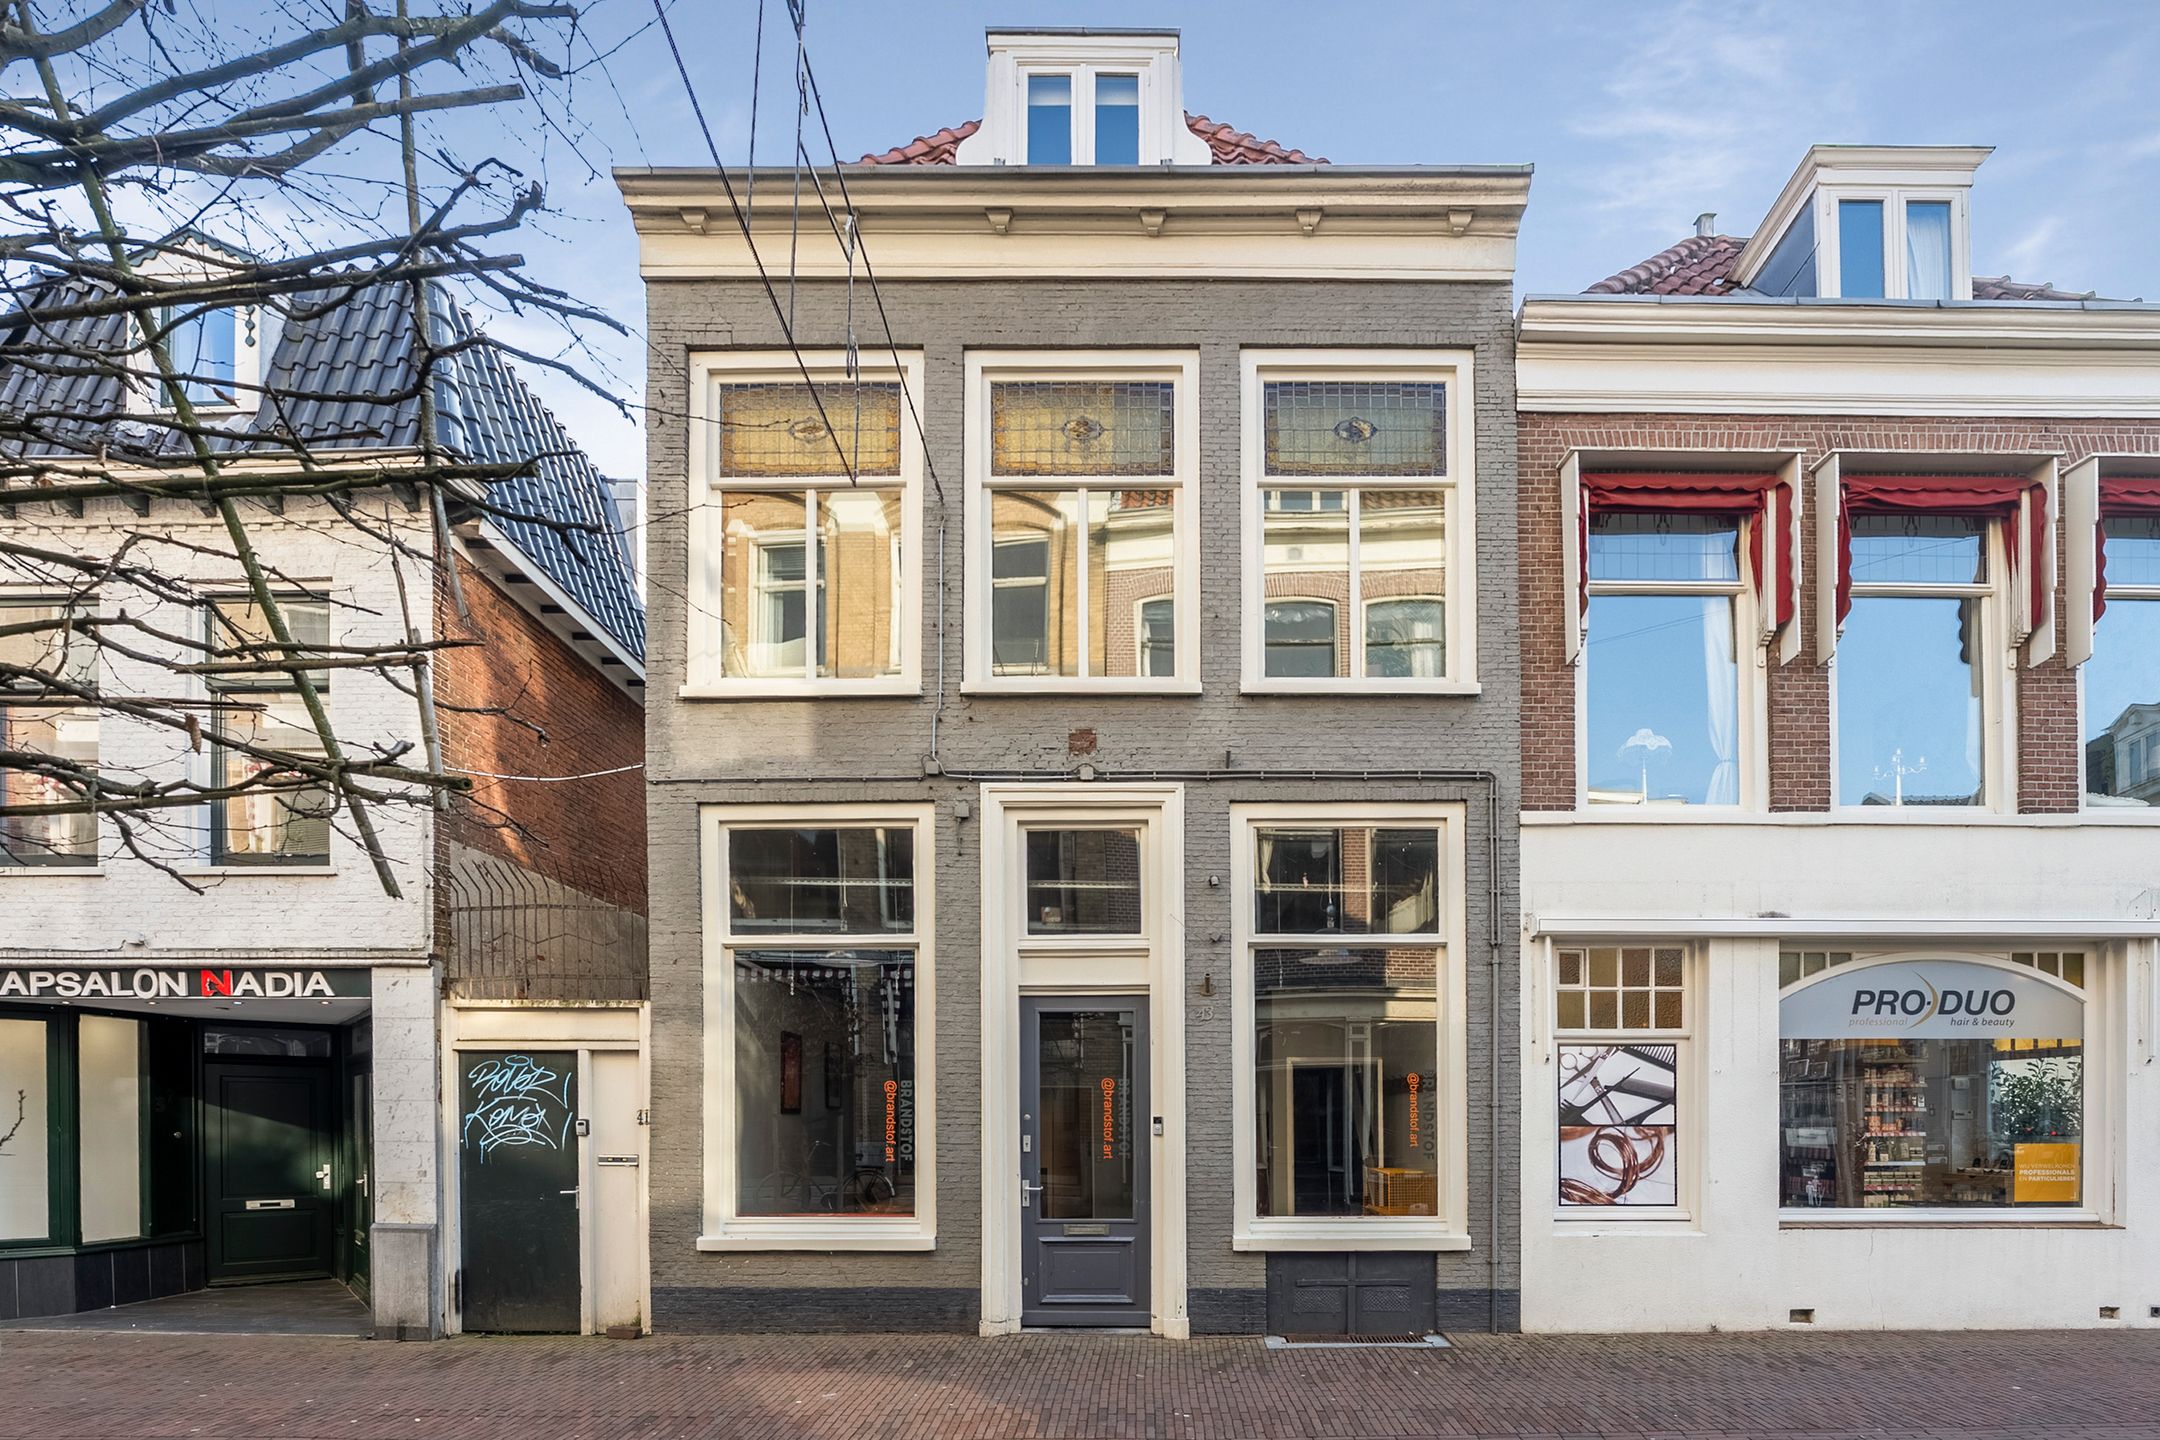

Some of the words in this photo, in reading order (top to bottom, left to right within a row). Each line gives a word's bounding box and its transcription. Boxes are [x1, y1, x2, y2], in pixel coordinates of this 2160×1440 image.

[0, 968, 188, 998] APSALON
[200, 968, 335, 997] NADIA
[1848, 1016, 1909, 1028] professional
[1950, 1016, 1970, 1026] hair
[1971, 1017, 1979, 1026] &
[1981, 1016, 2016, 1028] beauty
[636, 1109, 649, 1125] 41
[883, 1080, 897, 1162] @brandstof.art
[900, 1080, 913, 1161] BRANDSTOF
[1101, 1077, 1115, 1159] @brandstof.art
